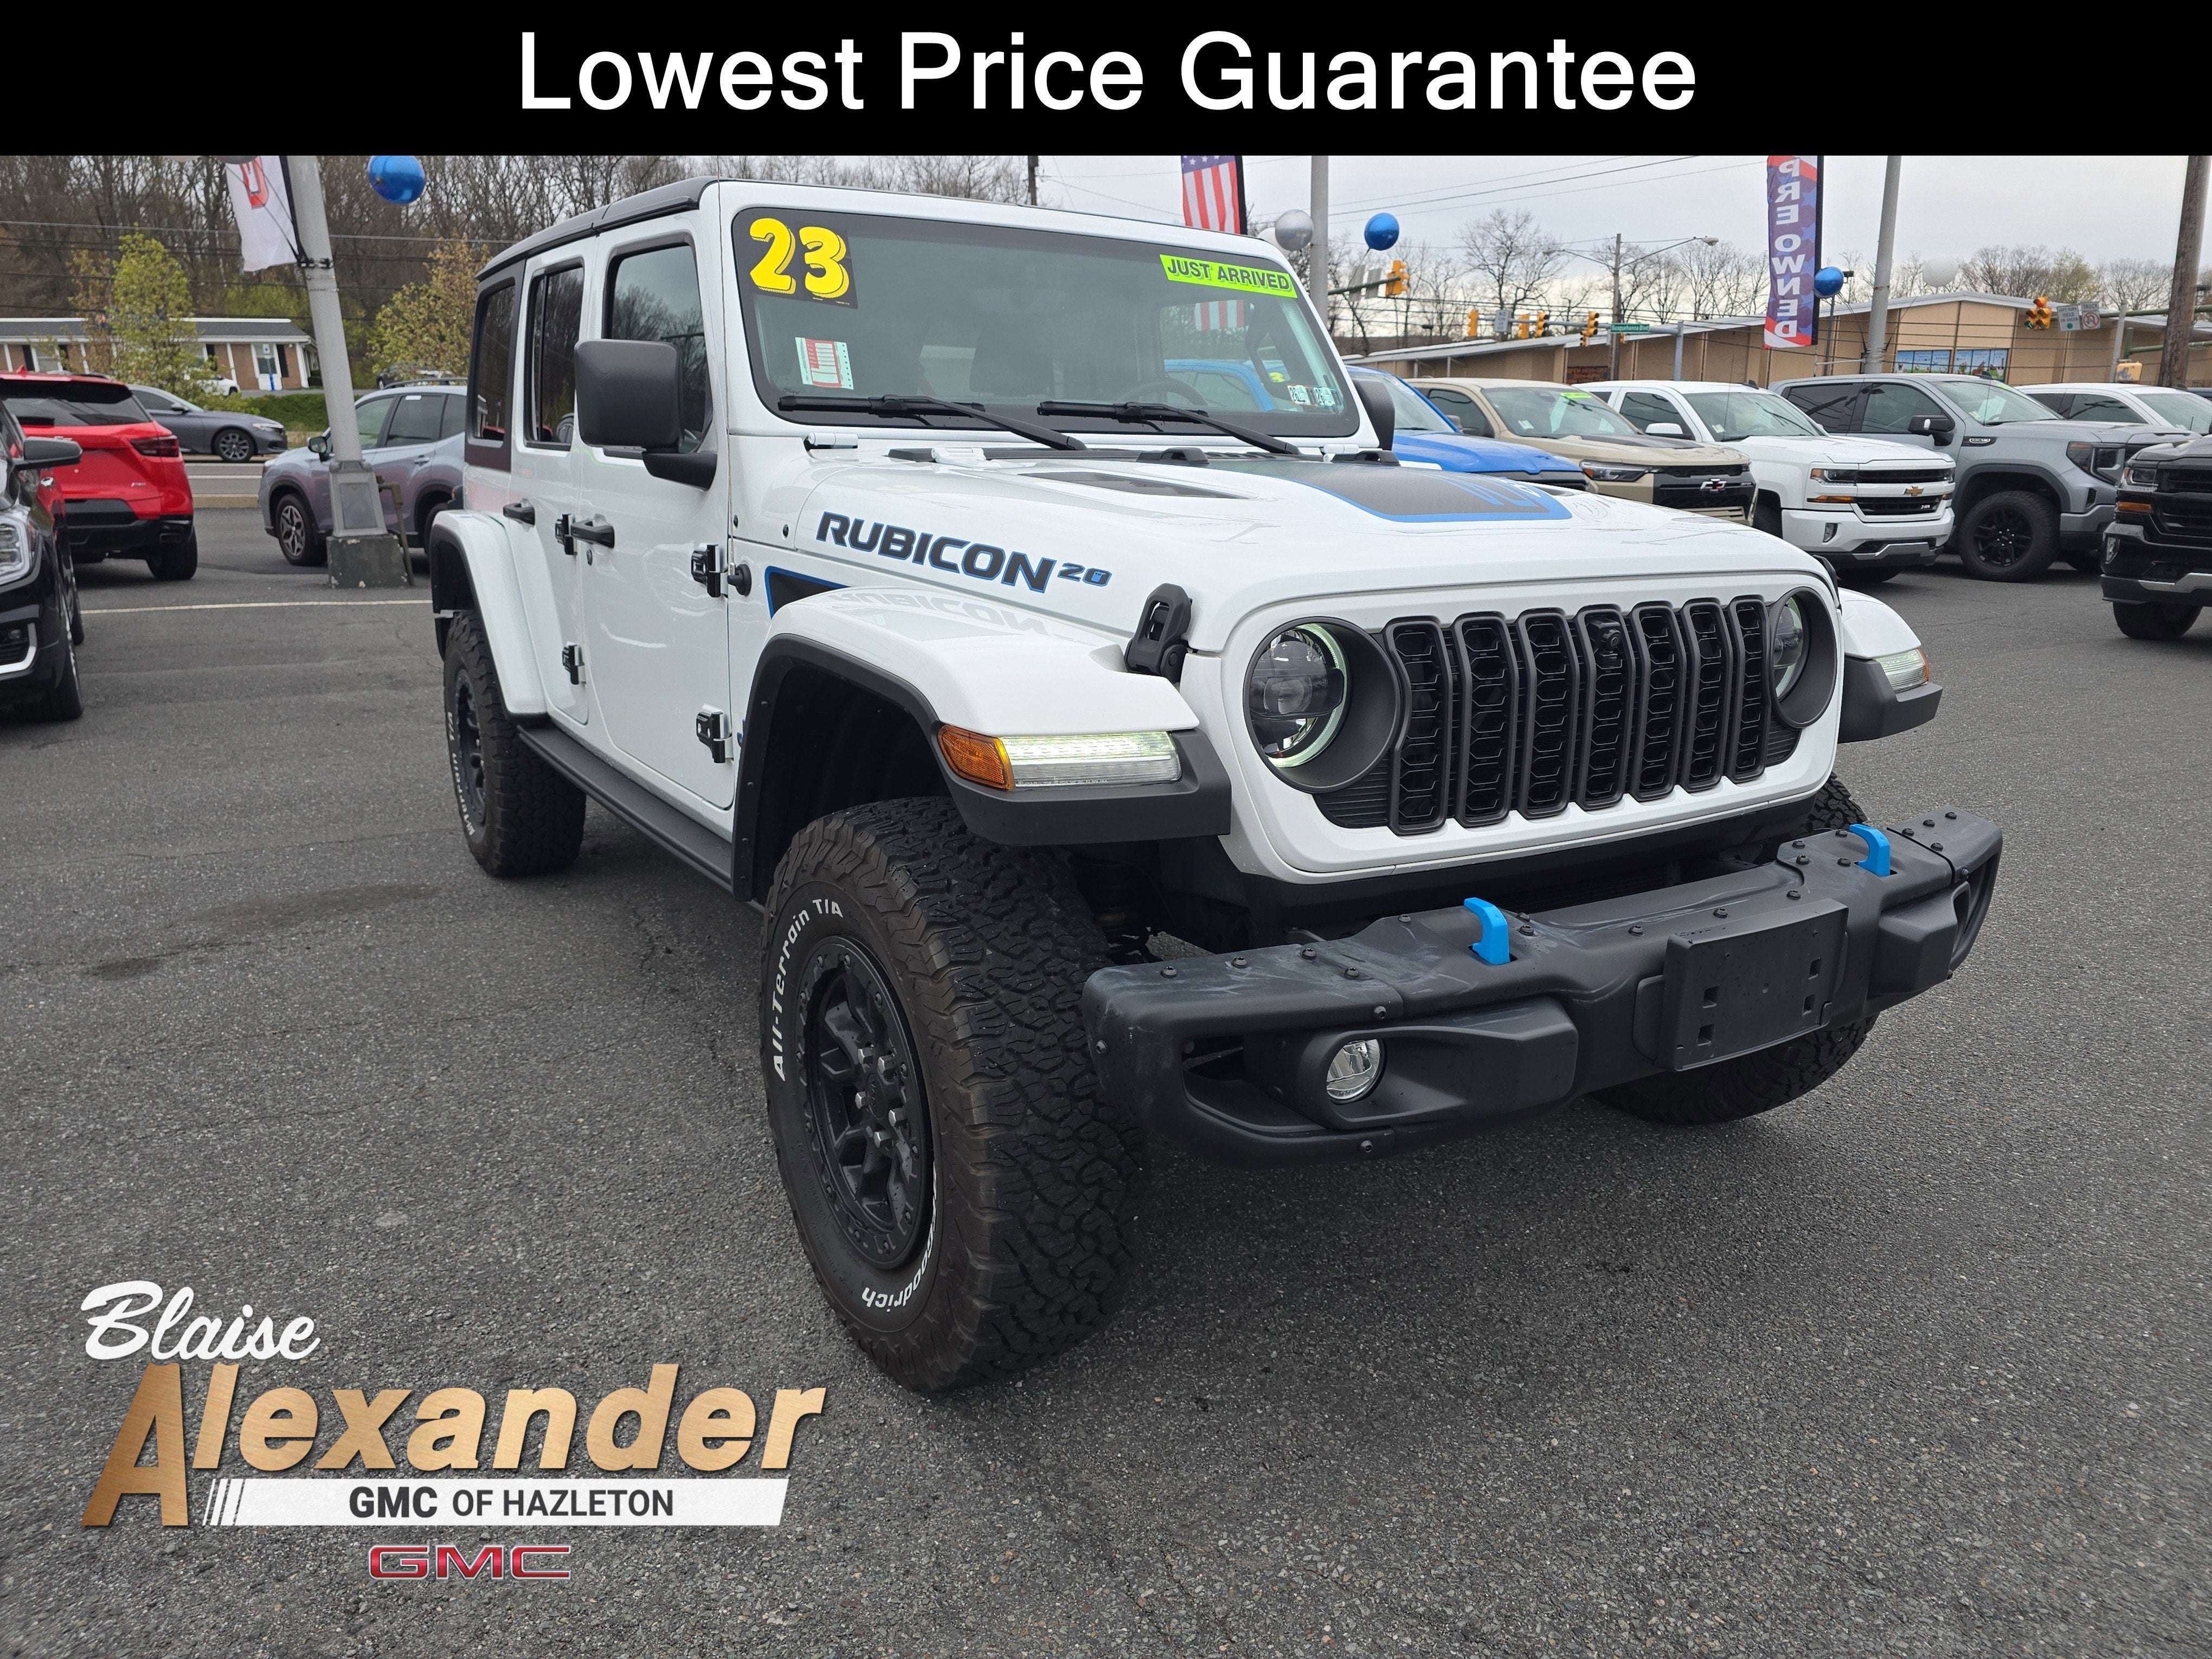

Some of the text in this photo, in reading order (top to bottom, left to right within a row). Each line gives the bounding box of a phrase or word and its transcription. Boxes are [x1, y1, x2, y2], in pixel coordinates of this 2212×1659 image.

[749, 217, 850, 298] 23
[1167, 259, 1291, 291] JUST ARRIVED
[816, 511, 1112, 594] RUBICON 20
[772, 909, 811, 1082] All-Terrain
